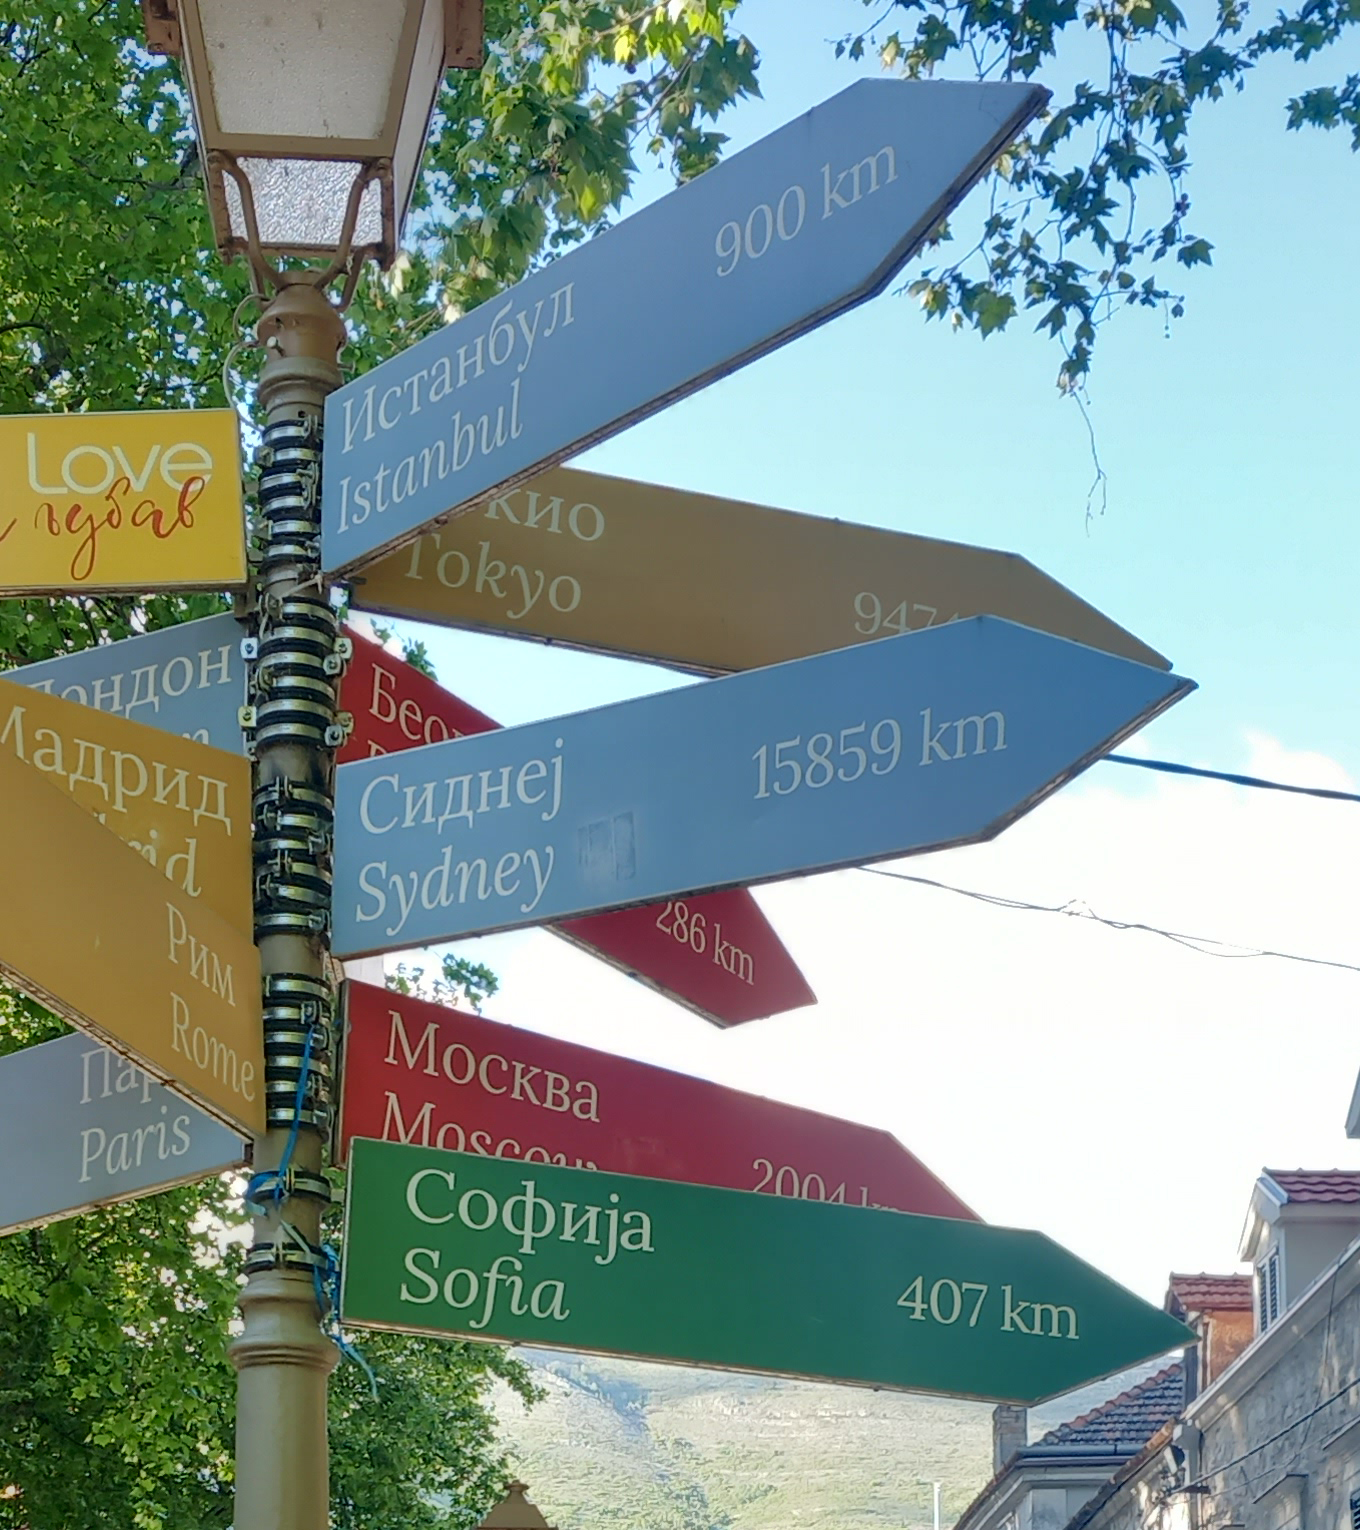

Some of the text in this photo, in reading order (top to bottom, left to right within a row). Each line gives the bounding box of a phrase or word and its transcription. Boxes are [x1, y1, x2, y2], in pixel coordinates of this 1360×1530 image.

[715, 145, 899, 277] 900 km
[341, 282, 575, 454] Истанбул
[26, 431, 213, 495] Love
[337, 377, 523, 534] Istanbul
[483, 488, 606, 542] кио
[404, 533, 582, 620] Tokyo
[853, 591, 959, 635] 947
[359, 737, 563, 835] Сиднеј
[751, 707, 1008, 799] 15859 km
[355, 845, 555, 936] Sydney
[166, 902, 236, 1007] Рим
[656, 901, 754, 986] 286 km
[170, 991, 256, 1102] Rome
[384, 1009, 601, 1123] Москва
[78, 1105, 191, 1183] Paris
[381, 1090, 598, 1171] Mos
[406, 1168, 655, 1266] Софија
[752, 1158, 846, 1205] 2004
[400, 1247, 570, 1329] Sofia
[896, 1275, 1080, 1340] 407 km
